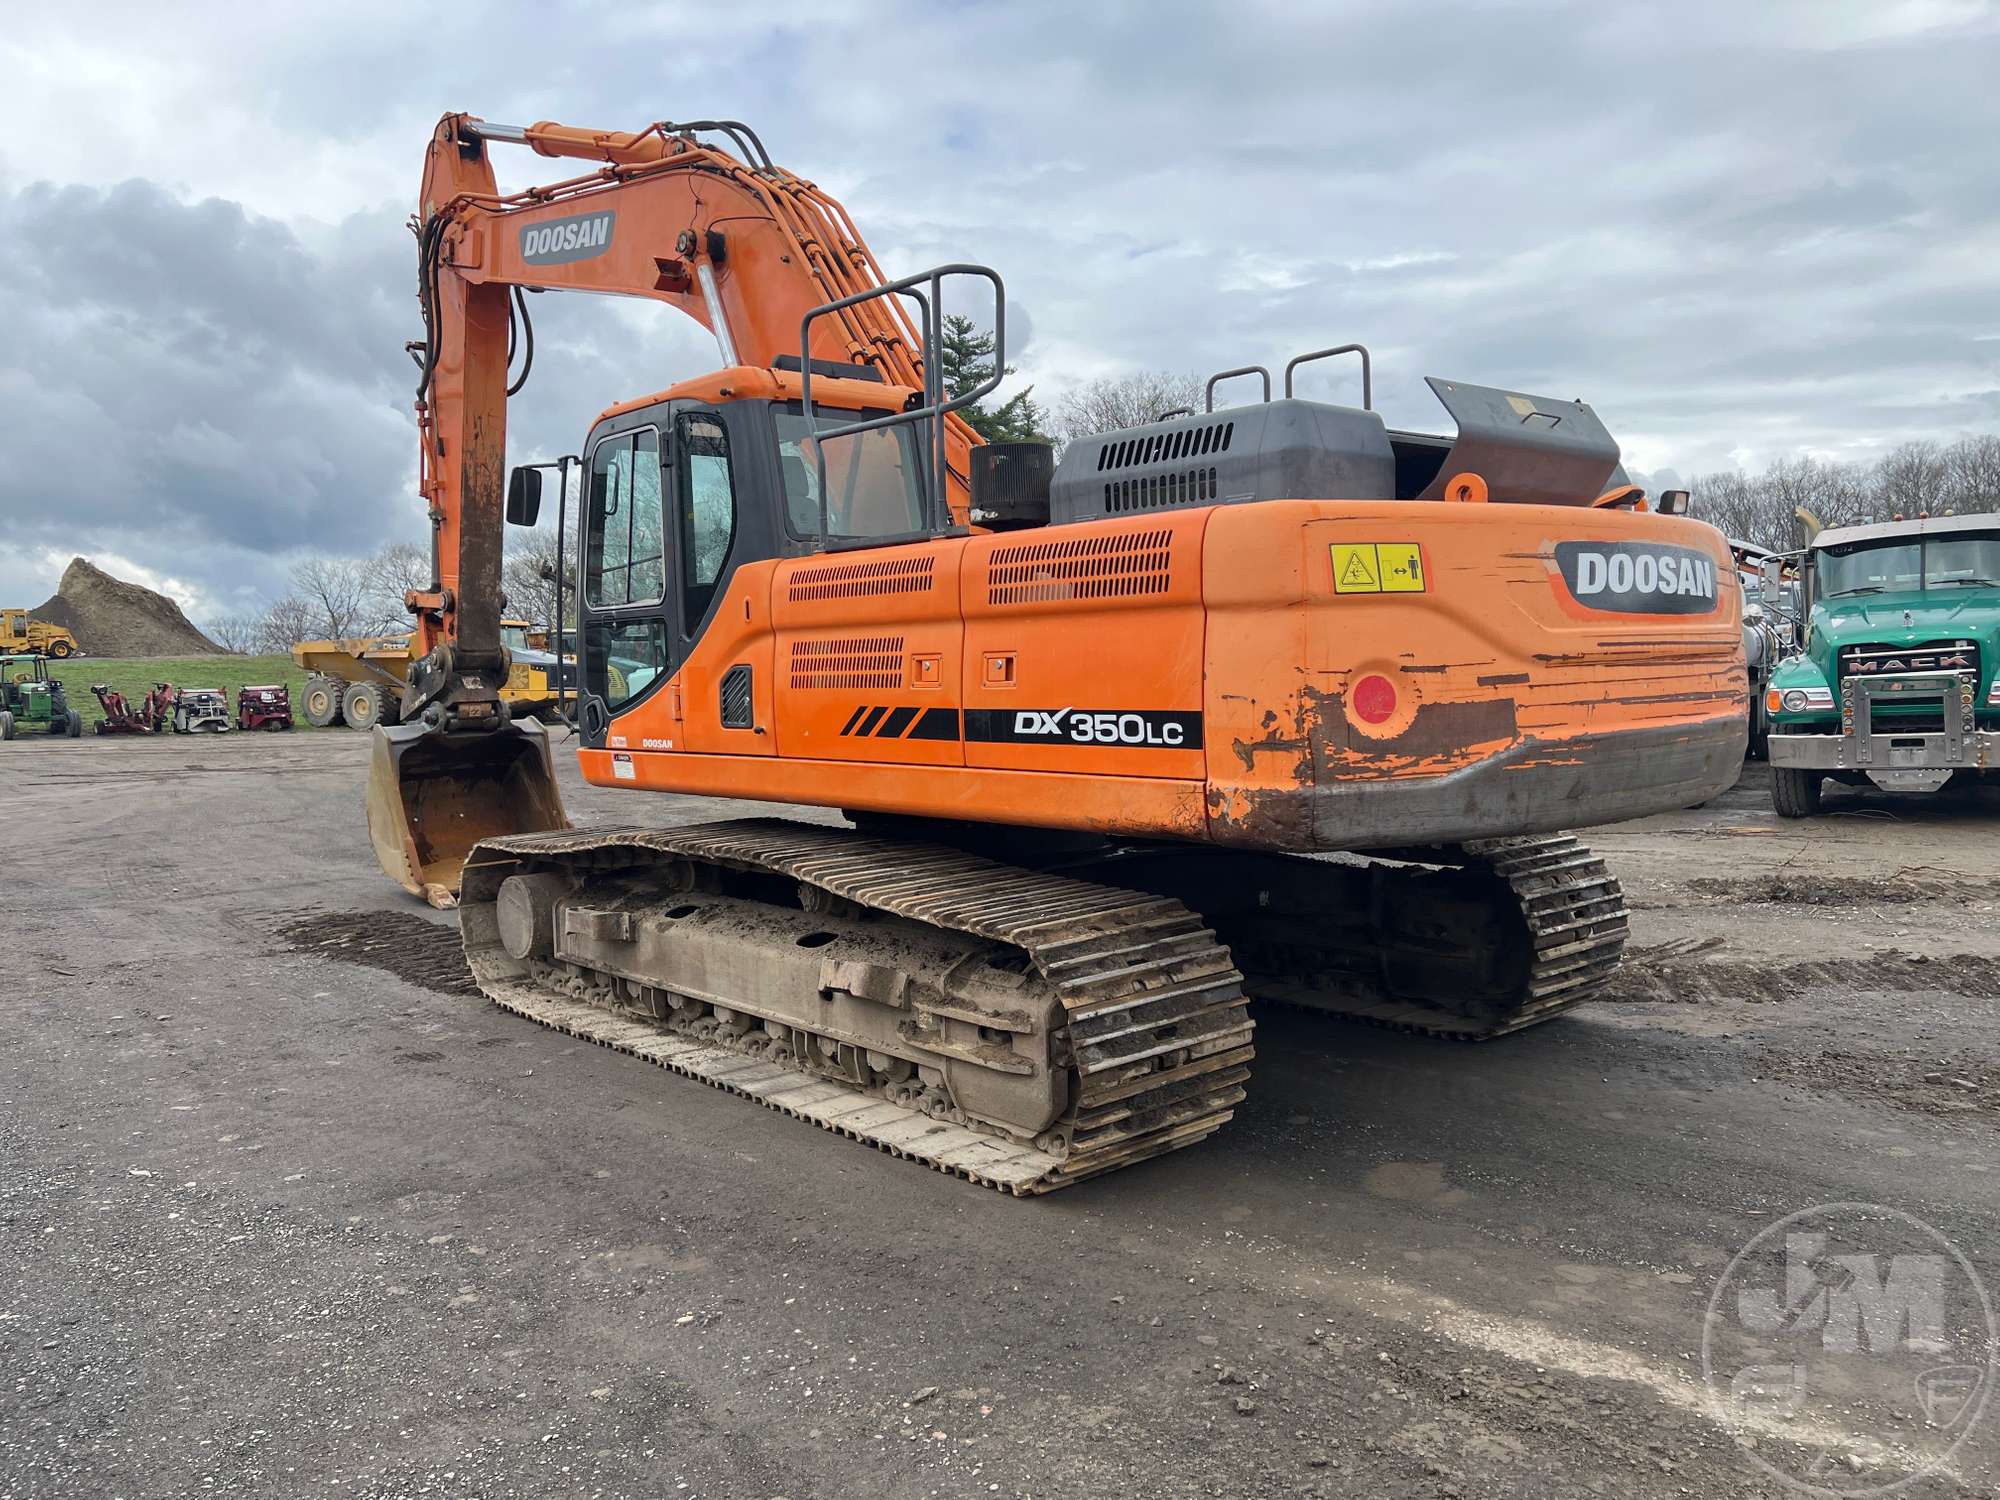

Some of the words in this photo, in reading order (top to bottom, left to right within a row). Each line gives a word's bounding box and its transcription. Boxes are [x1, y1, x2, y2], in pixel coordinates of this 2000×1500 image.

[524, 217, 608, 257] DOOSAN
[1577, 552, 1713, 598] DOOSAN
[1849, 655, 1970, 673] MACK
[643, 738, 672, 749] DOOSAN
